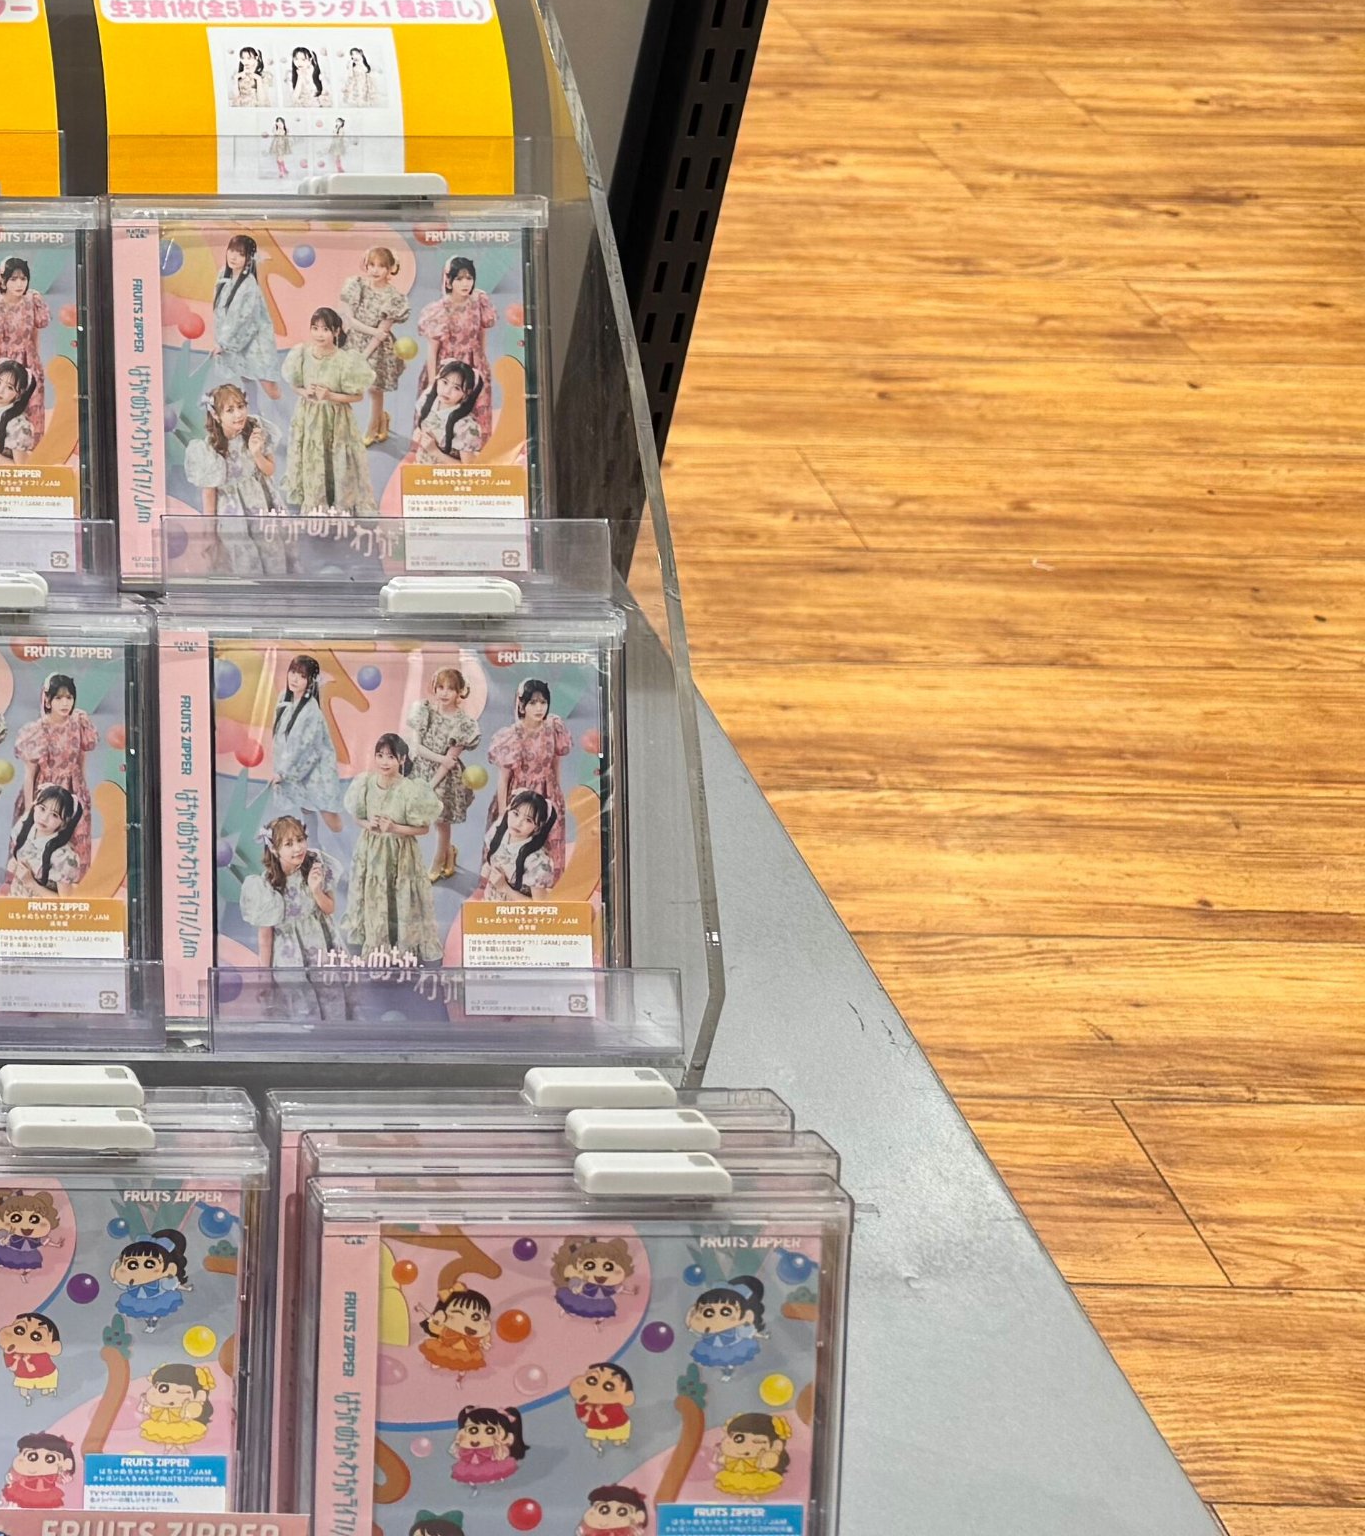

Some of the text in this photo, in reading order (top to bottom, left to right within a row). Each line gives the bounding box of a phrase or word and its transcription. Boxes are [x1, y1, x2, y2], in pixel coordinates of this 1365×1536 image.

[24, 232, 64, 243] ZIPPER
[425, 231, 509, 242] FRUITS ZIPPER
[24, 646, 112, 659] FRUITS ZIPPER
[498, 651, 587, 663] FRUITS ZIPPER
[124, 1191, 222, 1204] FRUITS ZIPPER
